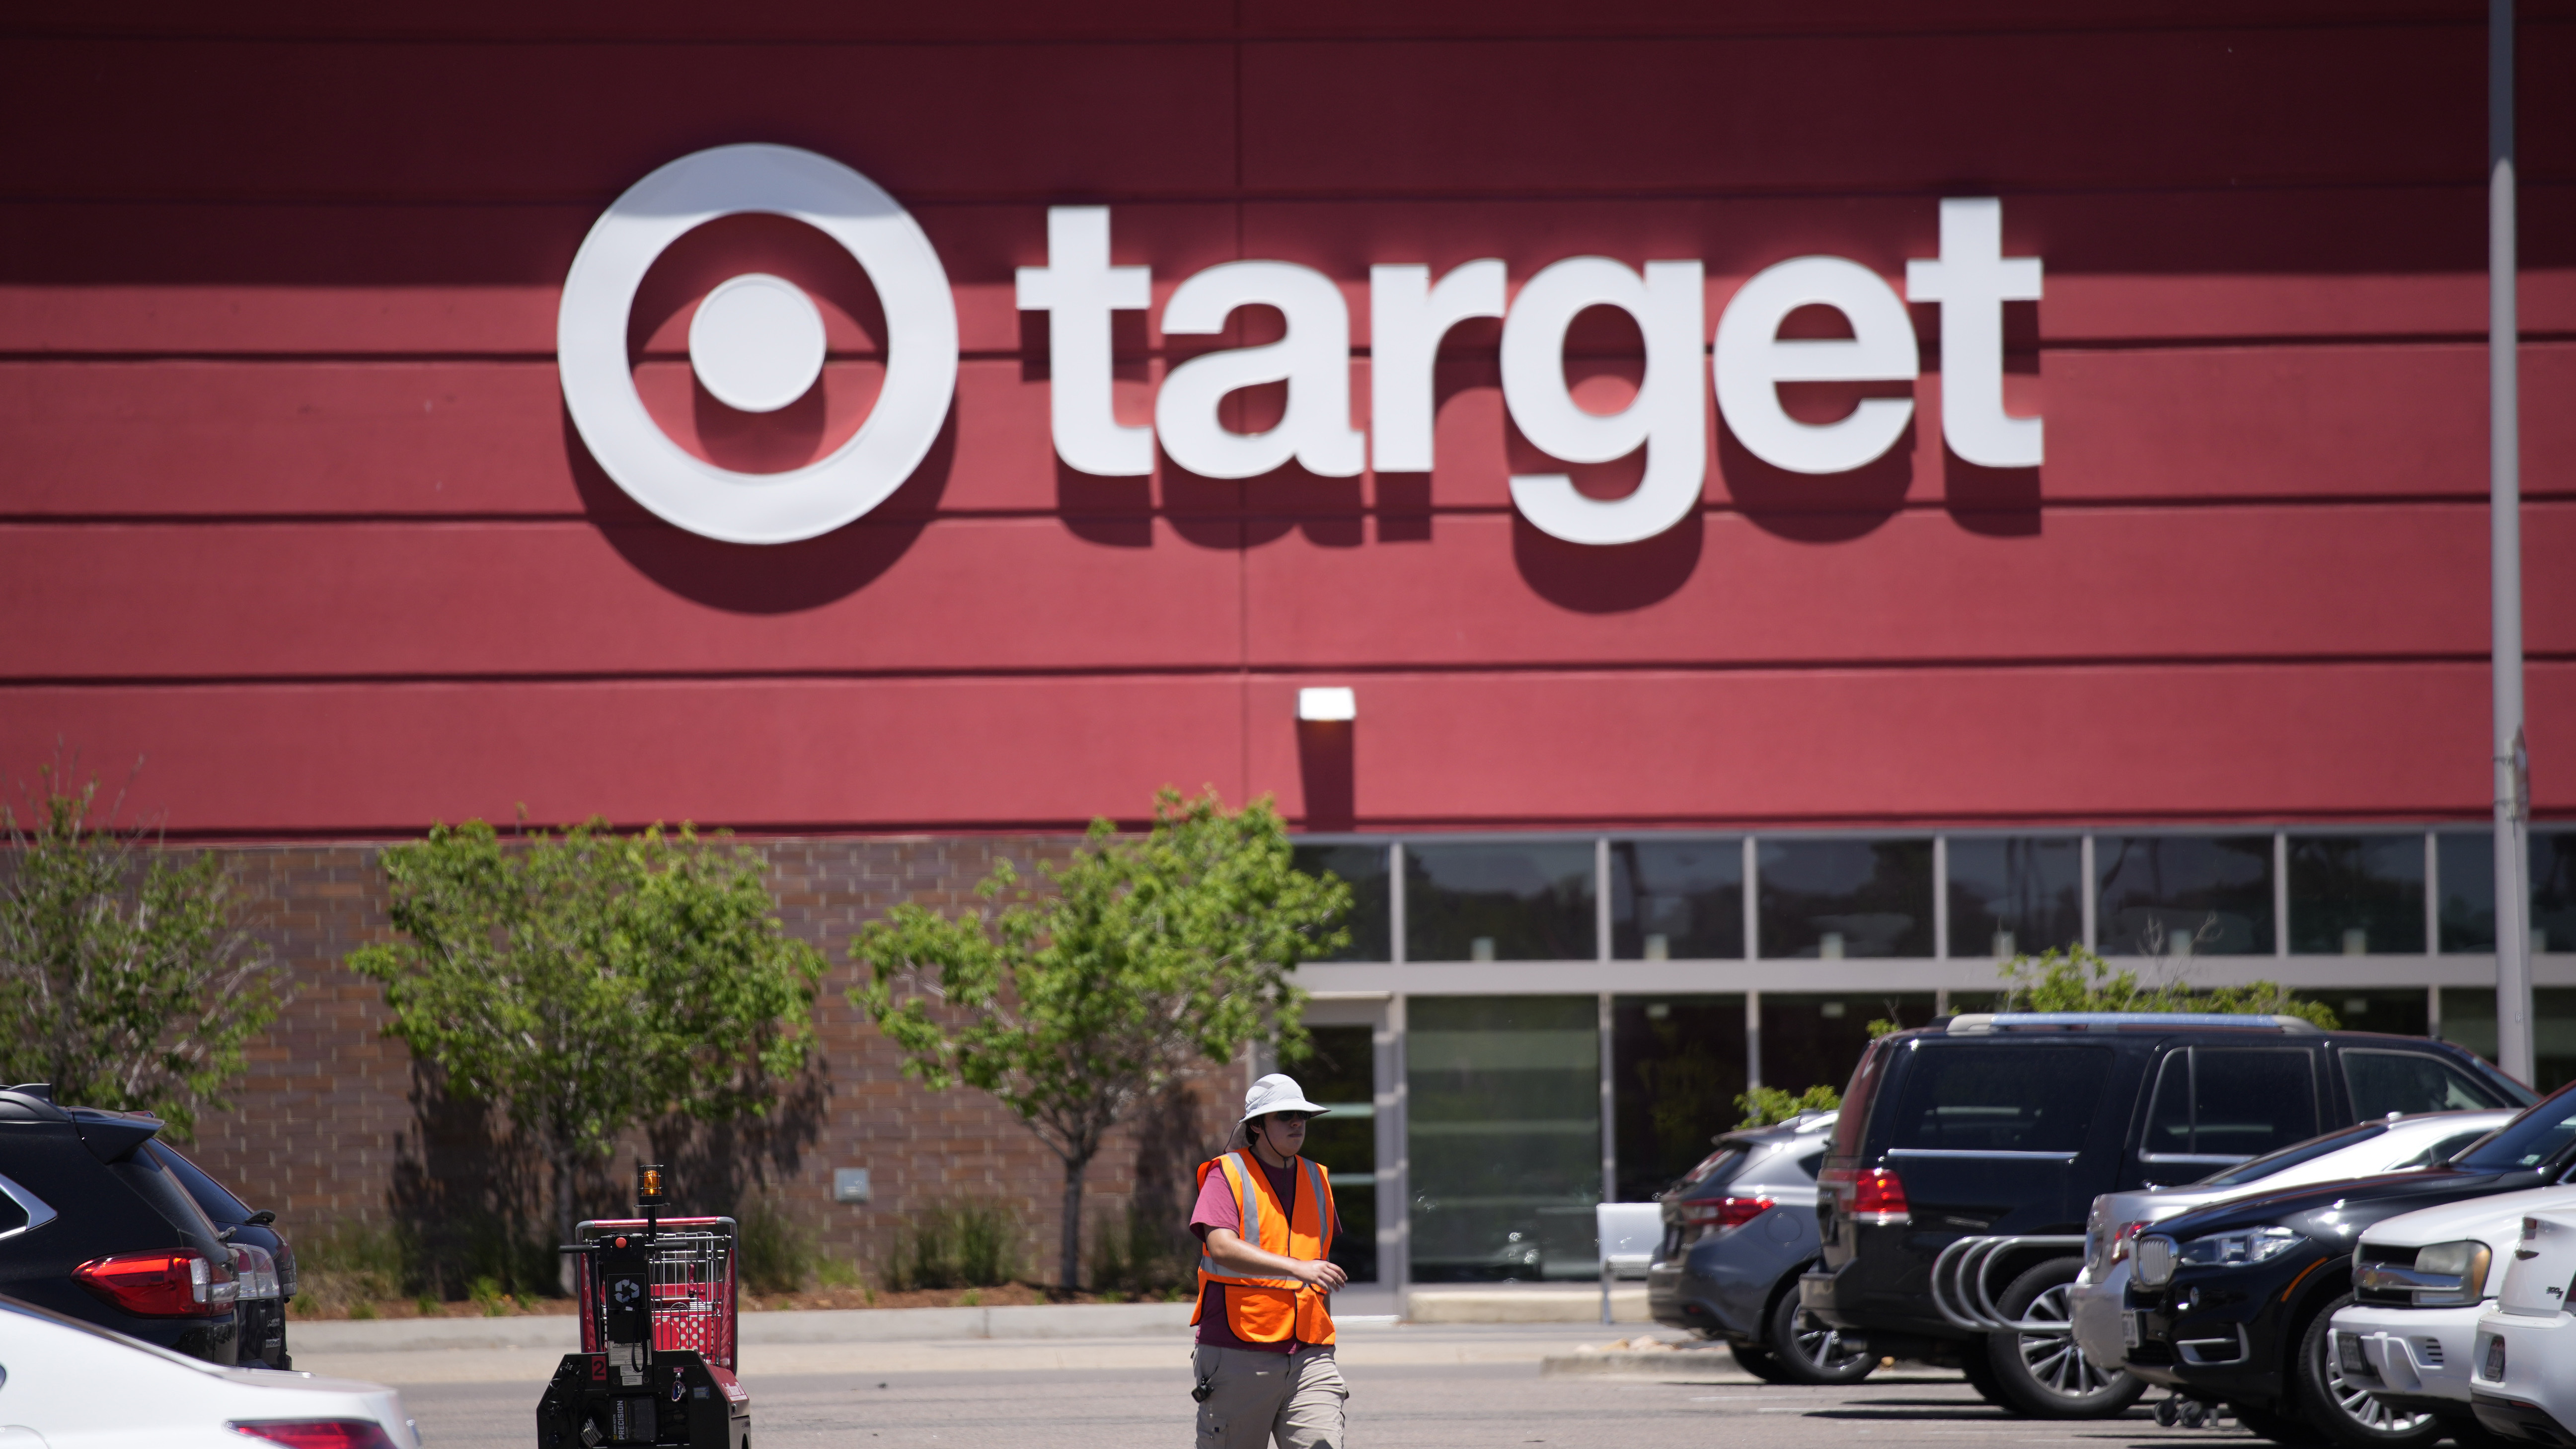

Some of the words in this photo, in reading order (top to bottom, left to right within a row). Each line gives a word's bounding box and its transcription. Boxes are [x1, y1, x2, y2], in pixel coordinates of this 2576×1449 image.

[1016, 198, 2045, 545] target
[594, 1360, 605, 1376] 2
[616, 1400, 625, 1440] PRECISION
